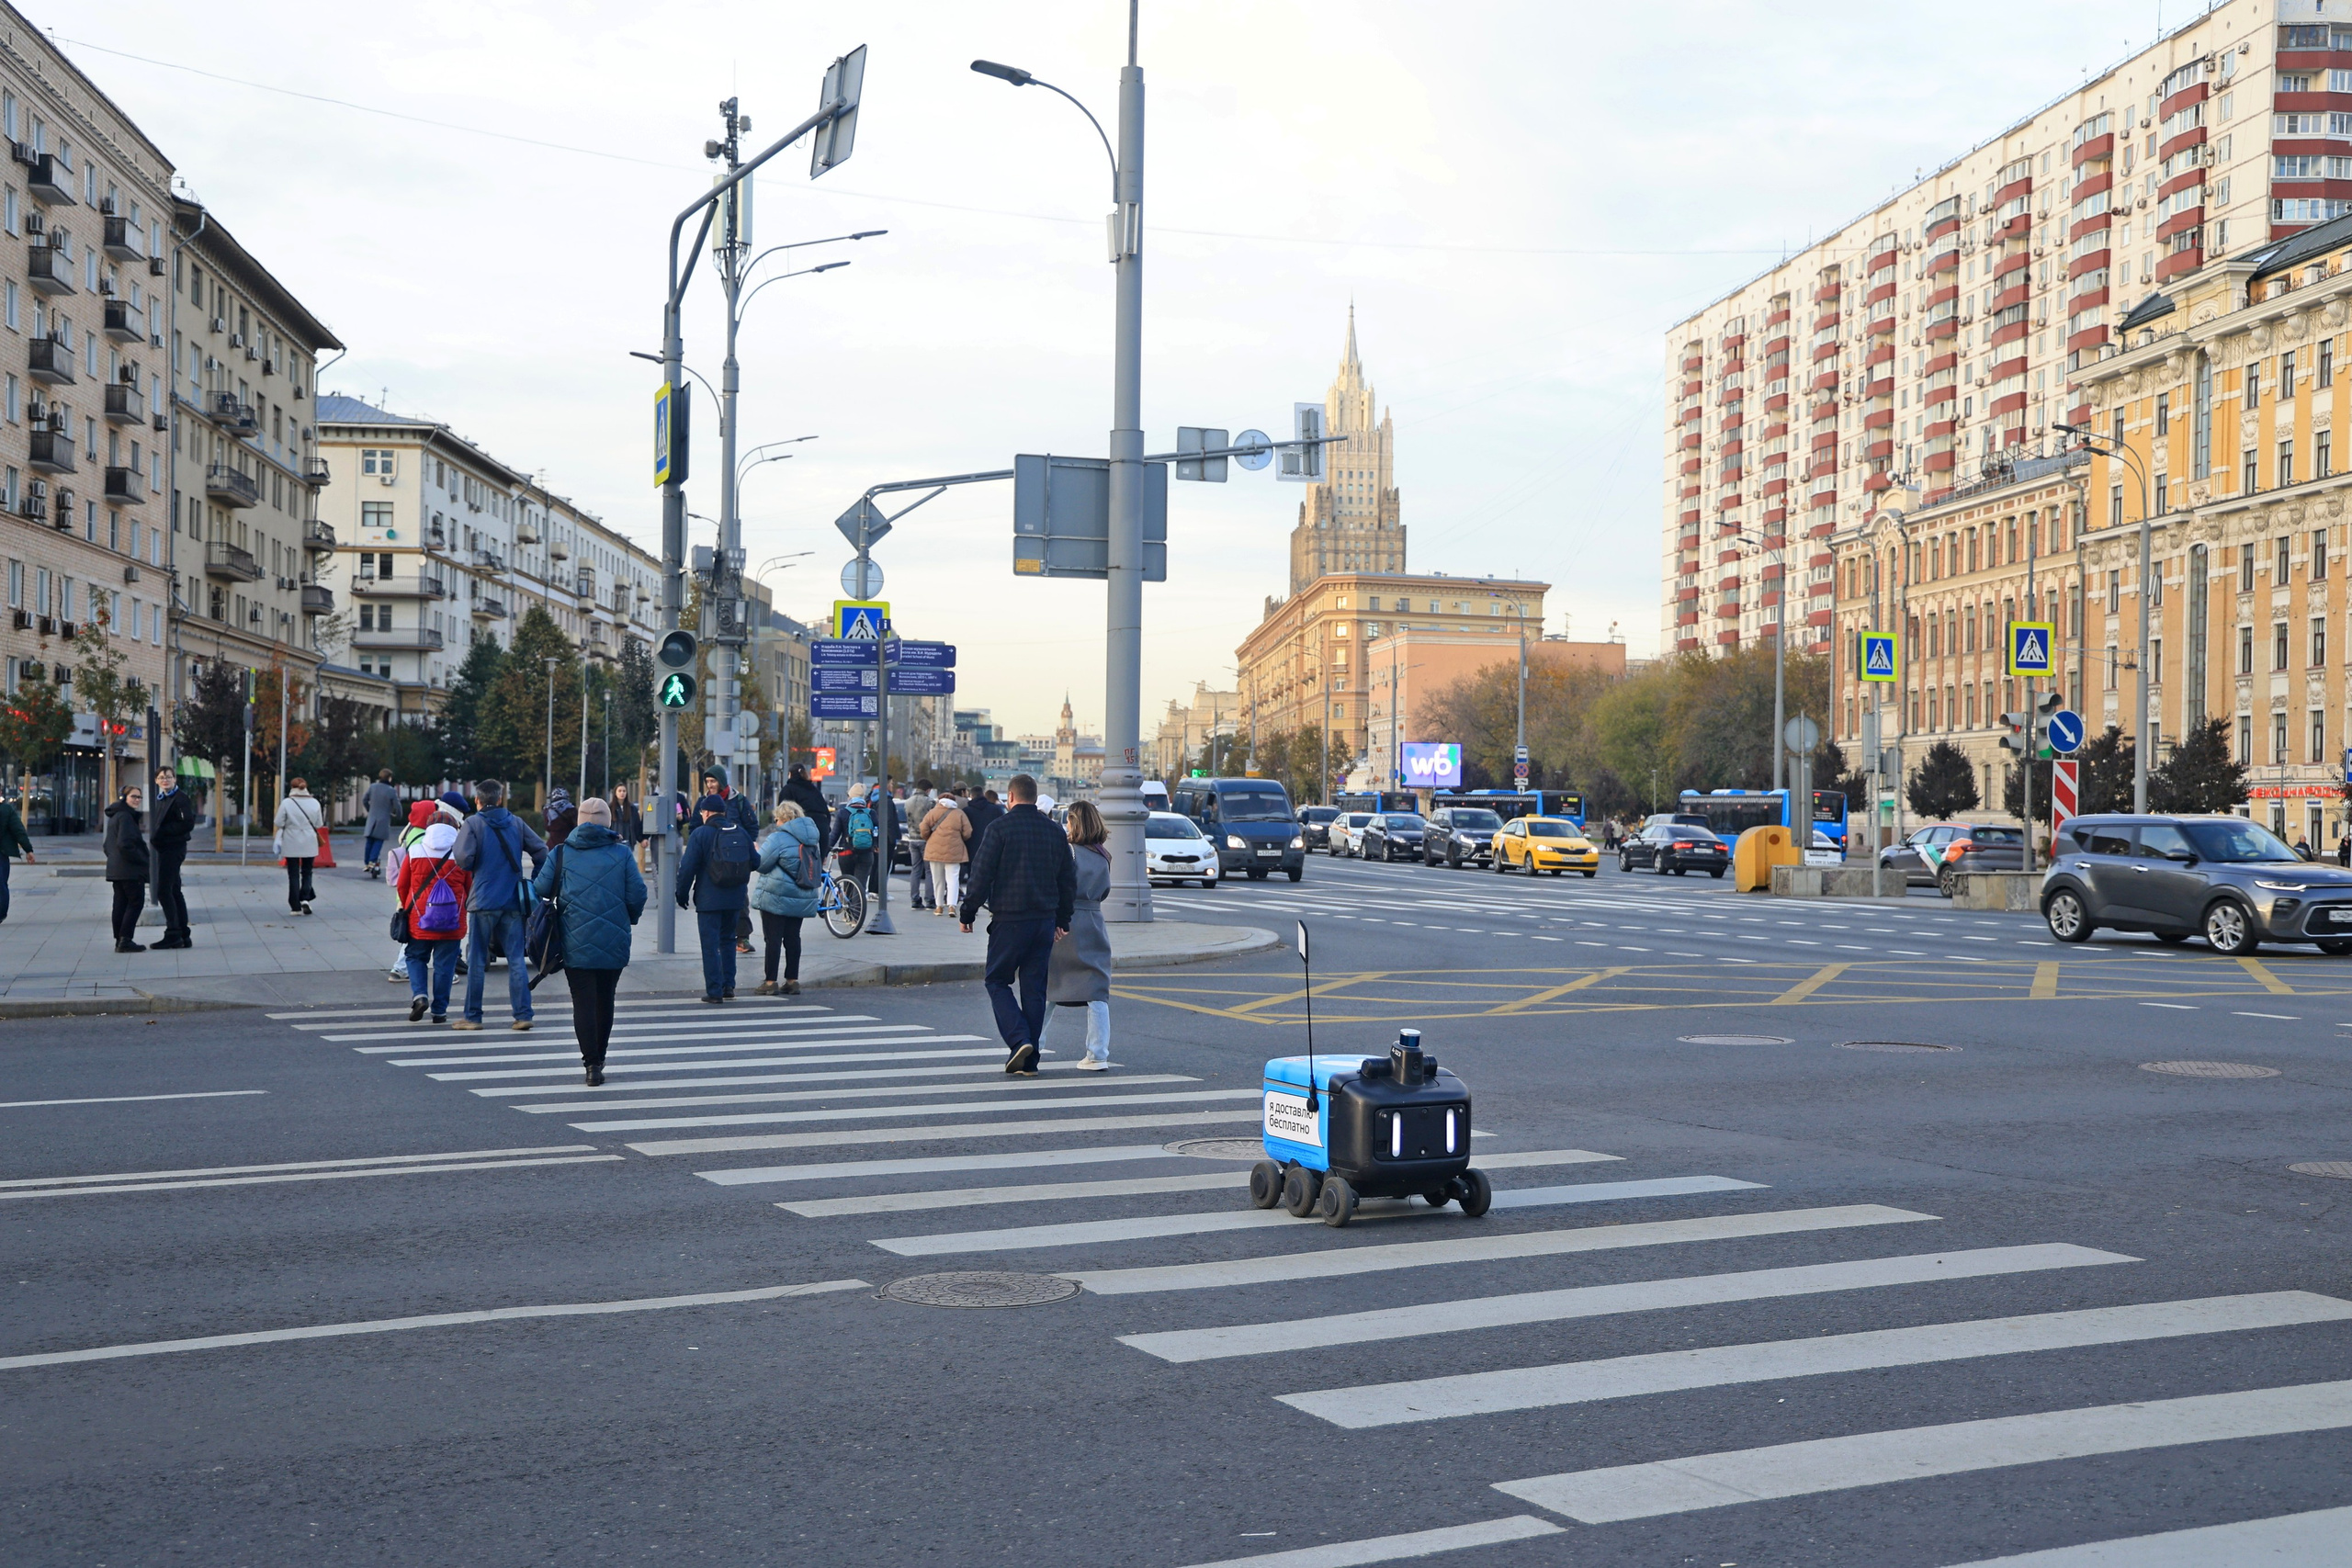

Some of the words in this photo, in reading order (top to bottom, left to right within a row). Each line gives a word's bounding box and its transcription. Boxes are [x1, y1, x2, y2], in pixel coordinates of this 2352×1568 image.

[1411, 750, 1452, 776] wb
[1269, 1101, 1274, 1111] я
[1269, 1114, 1310, 1134] бесплатно
